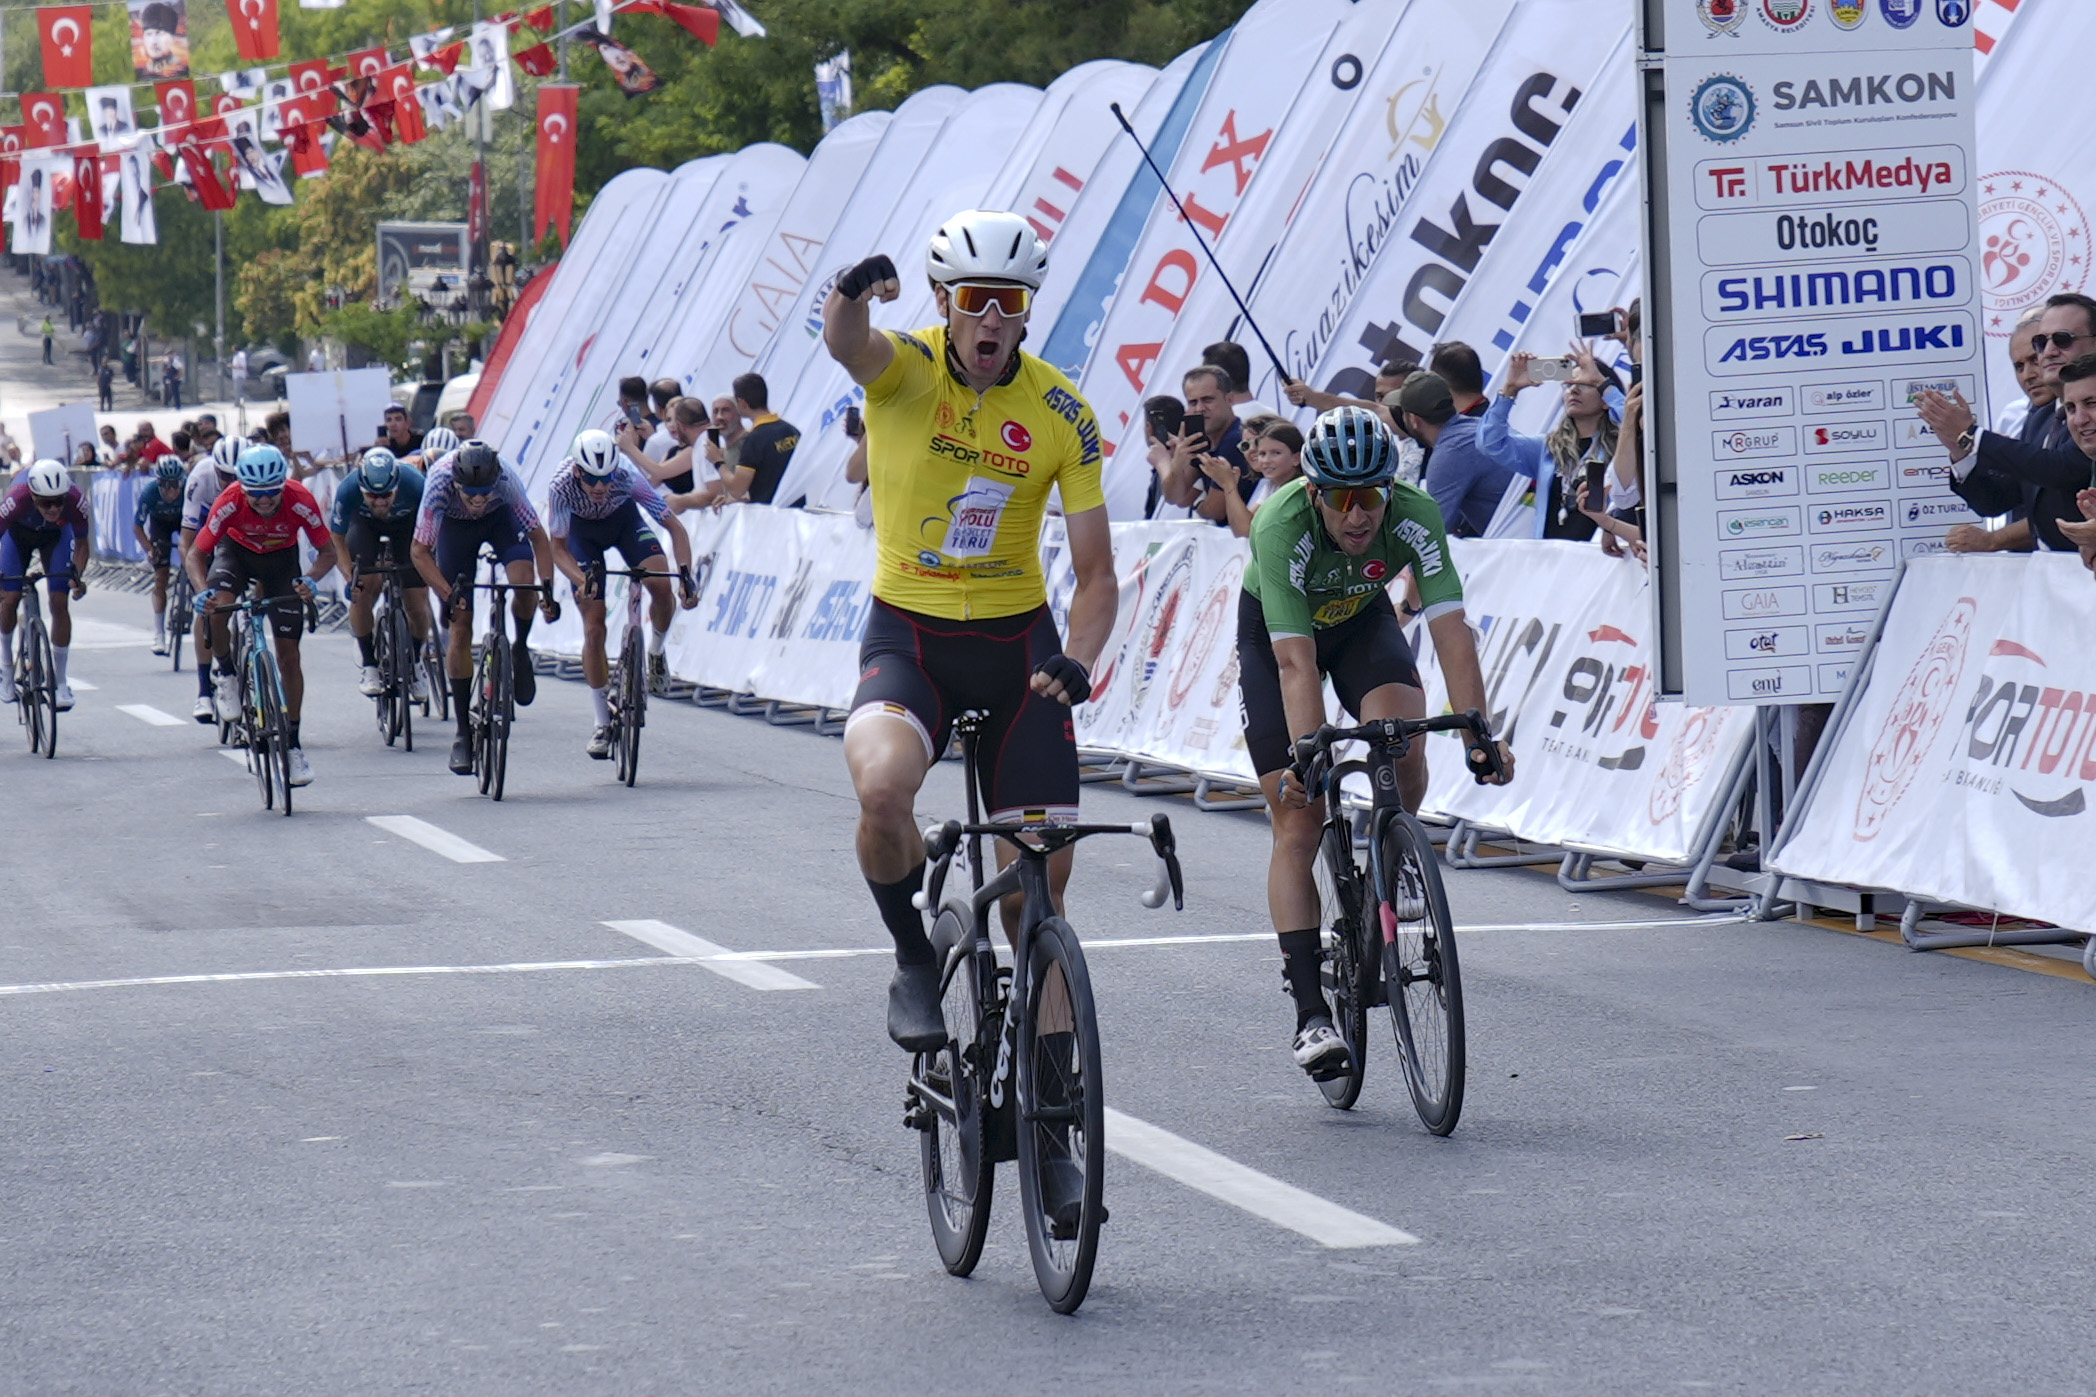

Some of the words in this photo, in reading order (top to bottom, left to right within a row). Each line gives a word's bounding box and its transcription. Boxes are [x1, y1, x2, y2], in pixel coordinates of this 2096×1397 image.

[1773, 71, 1955, 110] SAMKON
[1768, 157, 1952, 195] TürkMedya
[1777, 213, 1878, 252] Otokoç
[1718, 265, 1956, 312] SHIMANO
[1842, 324, 1963, 355] JUKI
[1737, 396, 1783, 409] varan
[1831, 428, 1877, 441] SOYLU
[1729, 471, 1784, 486] ASKON
[1834, 507, 1884, 518] HAKSA
[1741, 592, 1779, 610] GAIA
